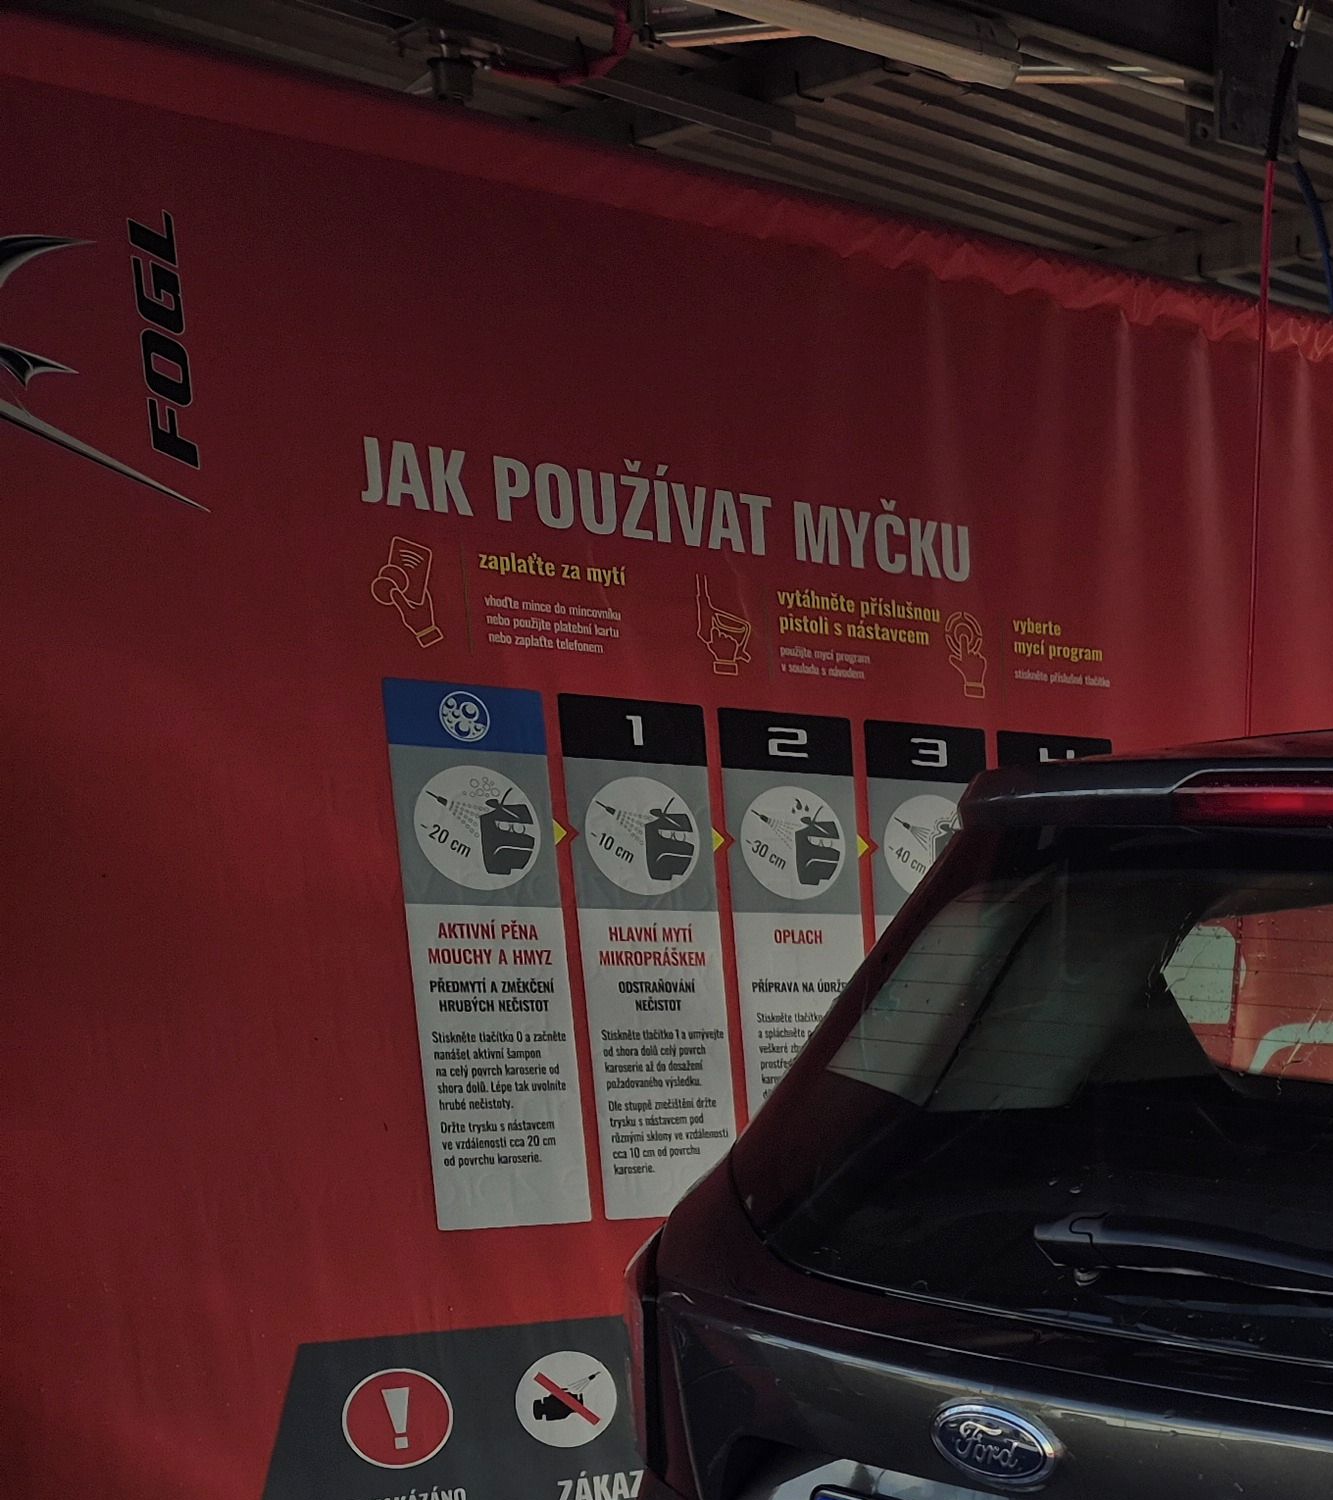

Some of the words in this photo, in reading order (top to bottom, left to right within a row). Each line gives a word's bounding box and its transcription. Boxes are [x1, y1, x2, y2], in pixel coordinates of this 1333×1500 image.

[126, 208, 201, 471] FOGL
[361, 435, 474, 517] JAK
[492, 455, 772, 556] POUŽÍVAT
[792, 498, 971, 583] MYČKU
[478, 552, 556, 577] zaplaťte
[561, 564, 581, 581] za
[586, 565, 626, 587] mytí
[521, 599, 552, 613] mince
[554, 602, 566, 614] do
[777, 588, 855, 613] vytáhněte
[860, 597, 941, 623] příslušnou
[486, 613, 510, 626] nebo
[553, 620, 592, 635] platební
[594, 624, 620, 638] kartu
[779, 613, 829, 635] pistoli
[833, 622, 842, 636] s
[847, 620, 930, 645] nástavcem
[1012, 617, 1062, 636] vyberte
[488, 632, 512, 645] nebo
[556, 638, 604, 654] telefonem
[1013, 639, 1045, 657] mycí
[1048, 644, 1103, 663] program
[625, 714, 644, 746] 1
[767, 726, 809, 758] 2
[910, 737, 948, 768] 3
[450, 840, 472, 858] cm
[615, 845, 634, 864] cm
[768, 852, 787, 870] cm
[910, 858, 926, 875] cm
[438, 919, 496, 940] AKTIVNÍ
[500, 920, 539, 941] PĚNA
[608, 922, 657, 943] HLAVNÍ
[662, 923, 693, 943] MYTÍ
[774, 928, 823, 945] OPLACH
[428, 948, 492, 965] MOUCHY
[498, 949, 508, 965] A
[513, 949, 553, 966] HMYZ
[599, 946, 706, 967] MIKROPRÁŠKEM
[429, 977, 486, 994] PŘEDMYTÍ
[490, 980, 498, 994] A
[501, 977, 555, 994] ZMĚKČENÍ
[618, 977, 696, 994] ODSTRAŇOVÁNÍ
[751, 977, 799, 994] PŘÍPRAVA
[802, 981, 815, 993] NA
[439, 996, 495, 1013] HRUBÝCH
[498, 997, 550, 1012] NEČISTOT
[635, 996, 682, 1012] NEČISTOT
[432, 1031, 477, 1044] Stiskněte
[479, 1030, 514, 1043] tlačítko
[525, 1032, 531, 1043] a
[533, 1030, 567, 1042] začněte
[434, 1048, 471, 1061] nanášet
[473, 1047, 504, 1060] aktivní
[507, 1048, 541, 1061] šampon
[603, 1046, 613, 1057] od
[679, 1043, 706, 1058] povrch
[435, 1067, 447, 1077] na
[449, 1065, 469, 1079] celý
[471, 1064, 503, 1080] povrch
[504, 1063, 546, 1076] karoserie
[549, 1063, 560, 1075] od
[604, 1061, 643, 1073] karoserie
[656, 1060, 666, 1072] do
[437, 1082, 464, 1094] shora
[490, 1080, 512, 1095] Lépe
[515, 1080, 529, 1092] tak
[439, 1098, 466, 1111] hrubé
[469, 1097, 514, 1111] nečistoty.
[440, 1121, 466, 1134] Držte
[468, 1120, 498, 1134] trysku
[500, 1122, 506, 1132] s
[507, 1119, 555, 1132] nástavcem
[610, 1117, 636, 1129] trysku
[441, 1140, 453, 1150] ve
[455, 1136, 507, 1150] vzdálenosti
[509, 1137, 525, 1148] cca
[527, 1135, 540, 1147] 20
[542, 1136, 557, 1147] cm
[443, 1154, 456, 1167] od
[458, 1153, 495, 1169] povrchu
[497, 1152, 542, 1165] karoserie.
[630, 1147, 640, 1159] 10
[955, 1420, 1022, 1469] Ford
